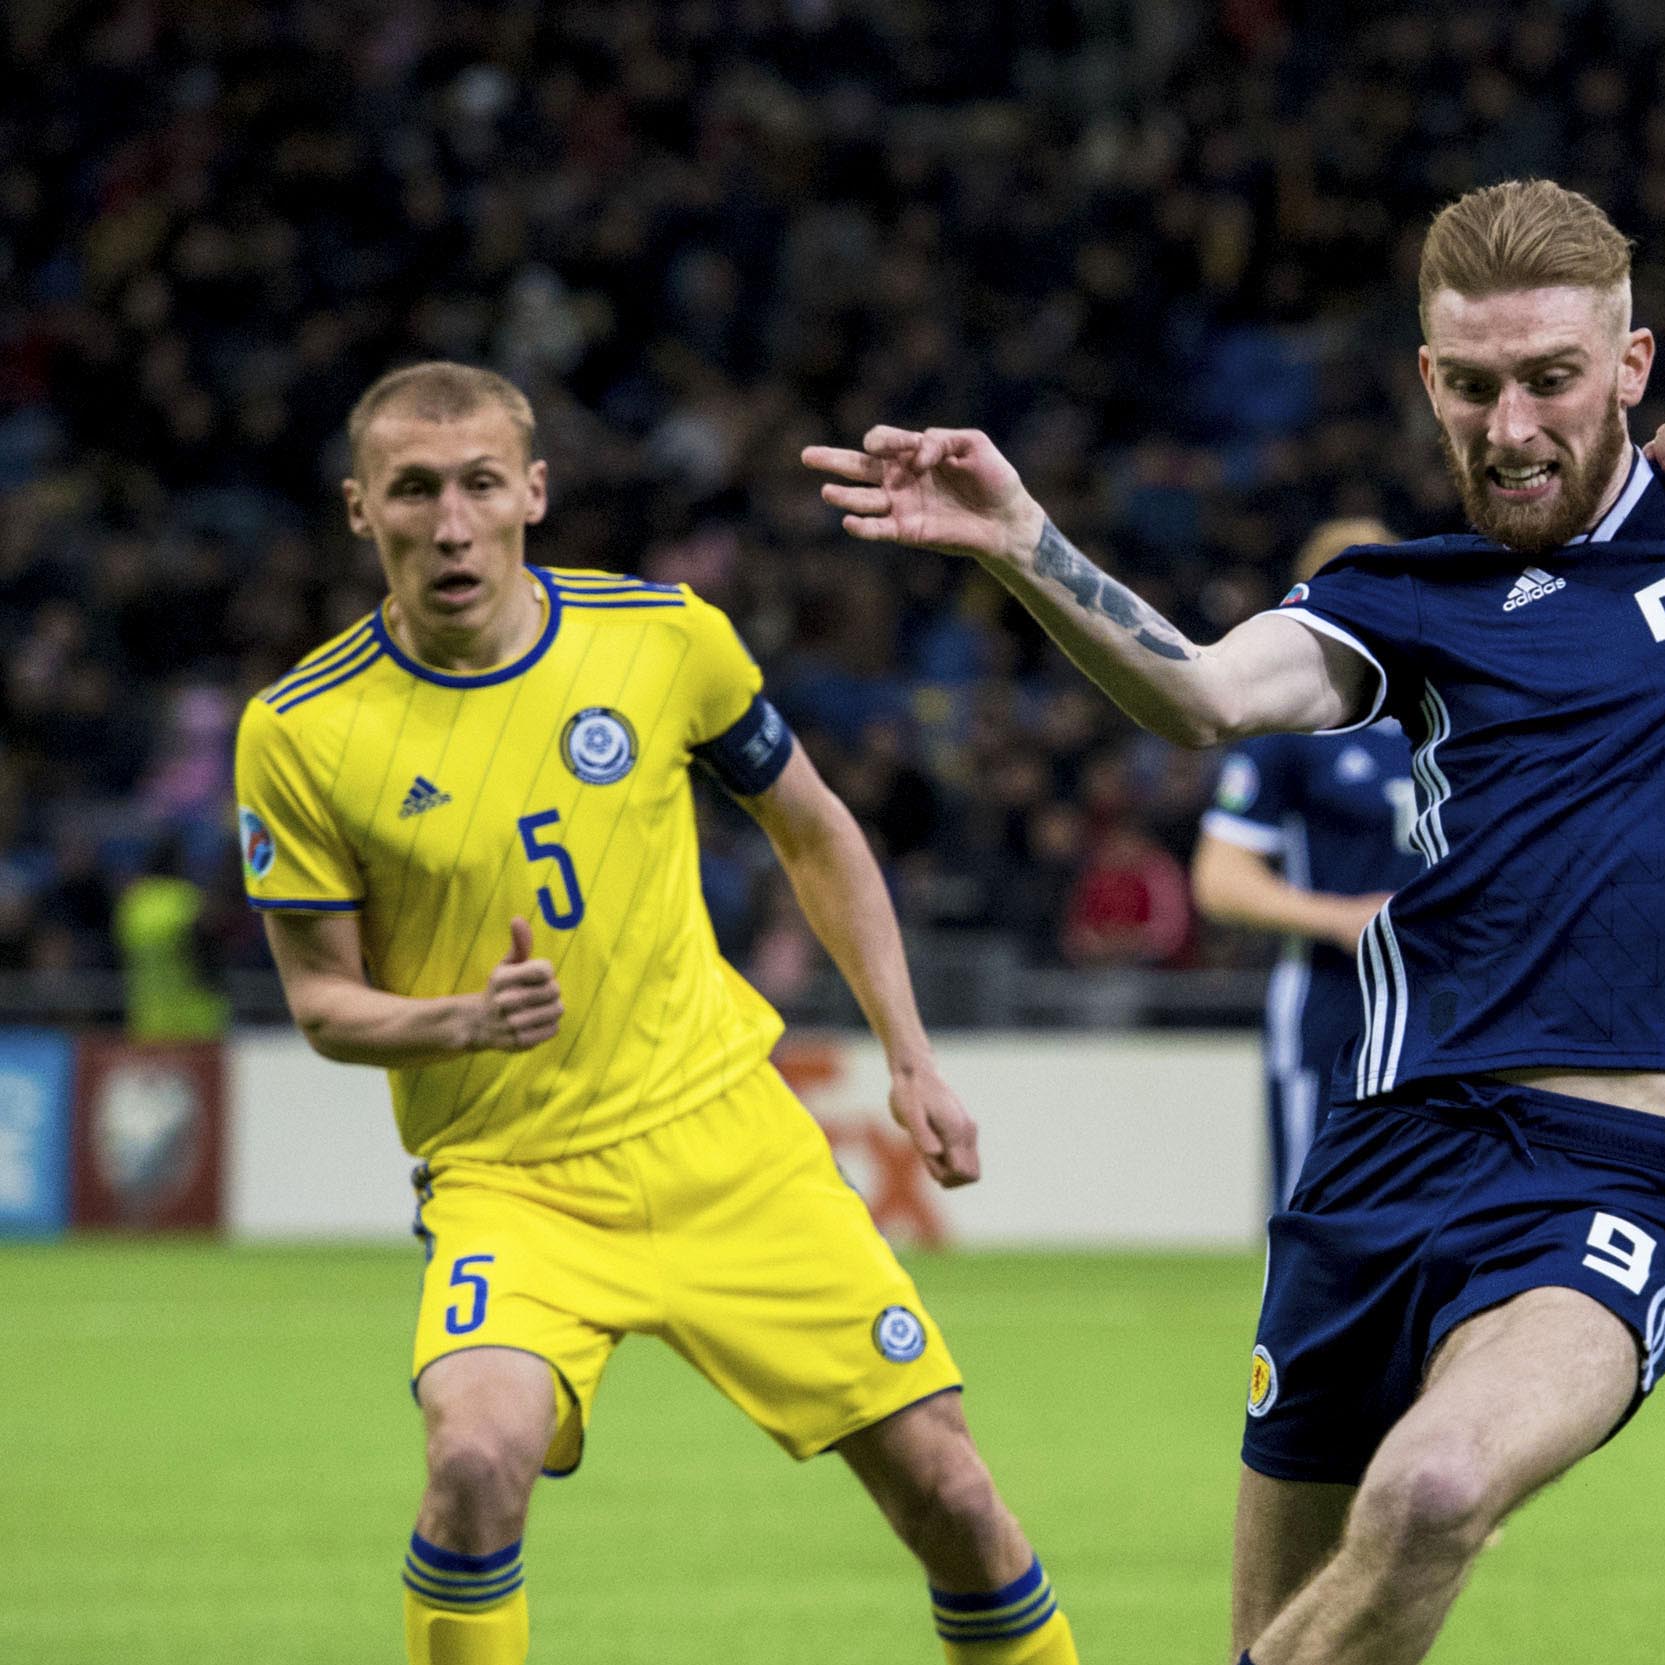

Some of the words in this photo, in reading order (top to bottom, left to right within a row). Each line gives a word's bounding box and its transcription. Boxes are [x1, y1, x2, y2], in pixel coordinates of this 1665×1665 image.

[1502, 577, 1567, 612] adidas
[517, 808, 586, 930] 5
[445, 1254, 495, 1334] 5
[1582, 1211, 1657, 1295] 9
